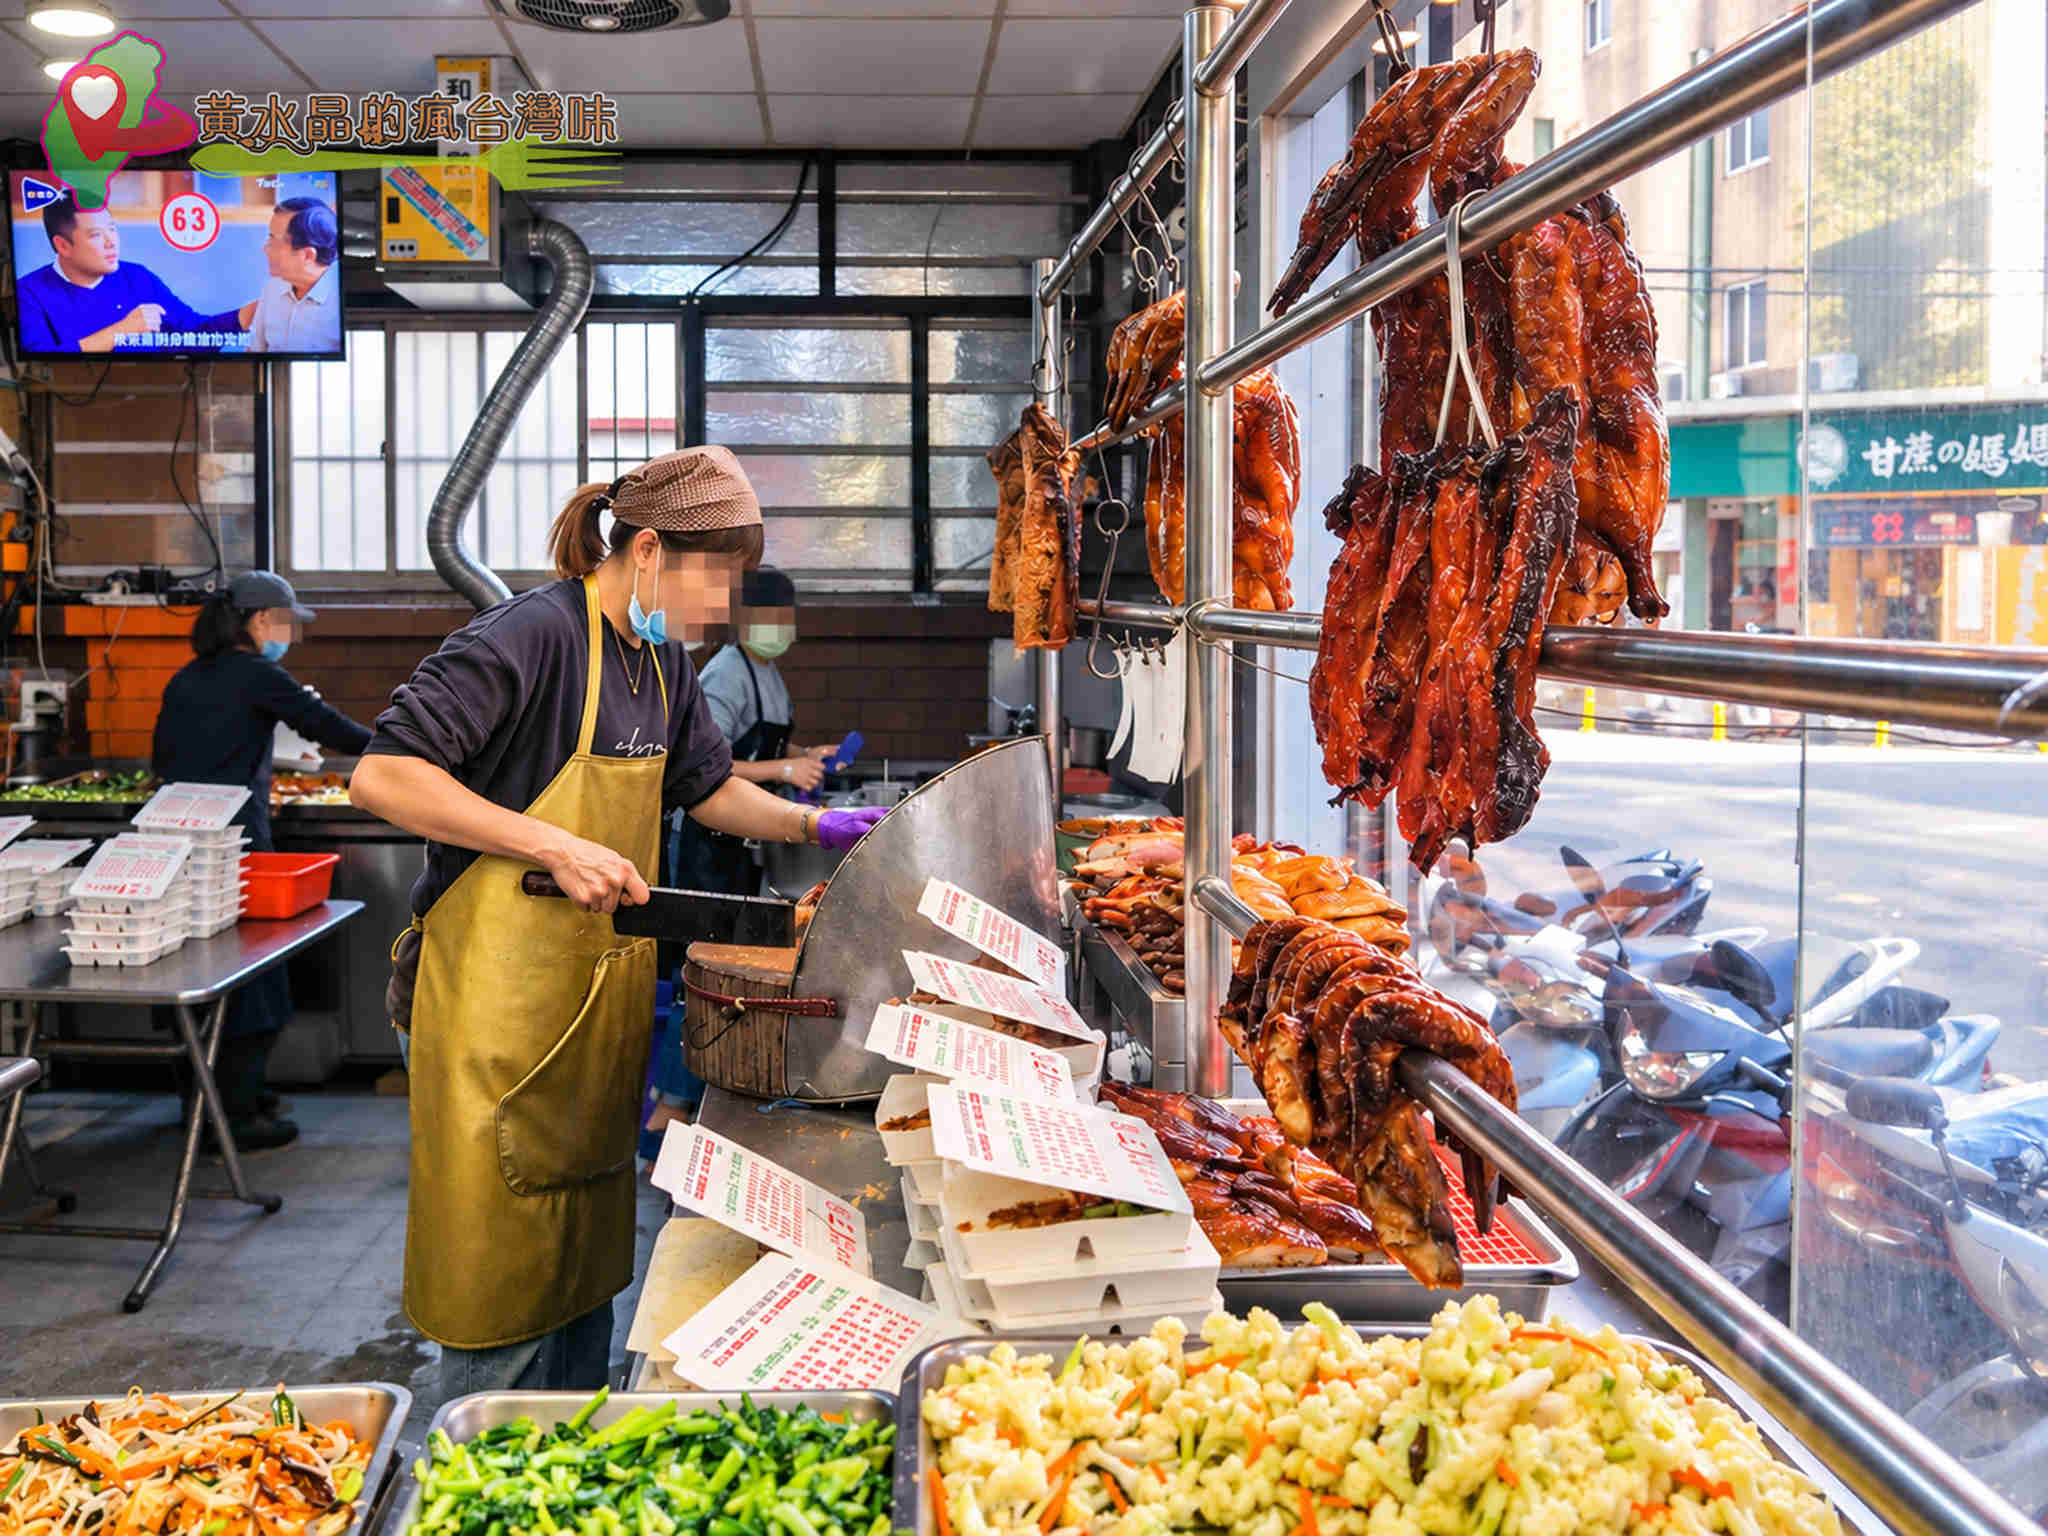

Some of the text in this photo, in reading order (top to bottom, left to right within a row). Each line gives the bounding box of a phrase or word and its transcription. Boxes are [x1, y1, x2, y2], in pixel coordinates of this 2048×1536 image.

[172, 206, 206, 232] 63
[1861, 423, 2048, 479] 甘蔗の媽媽
